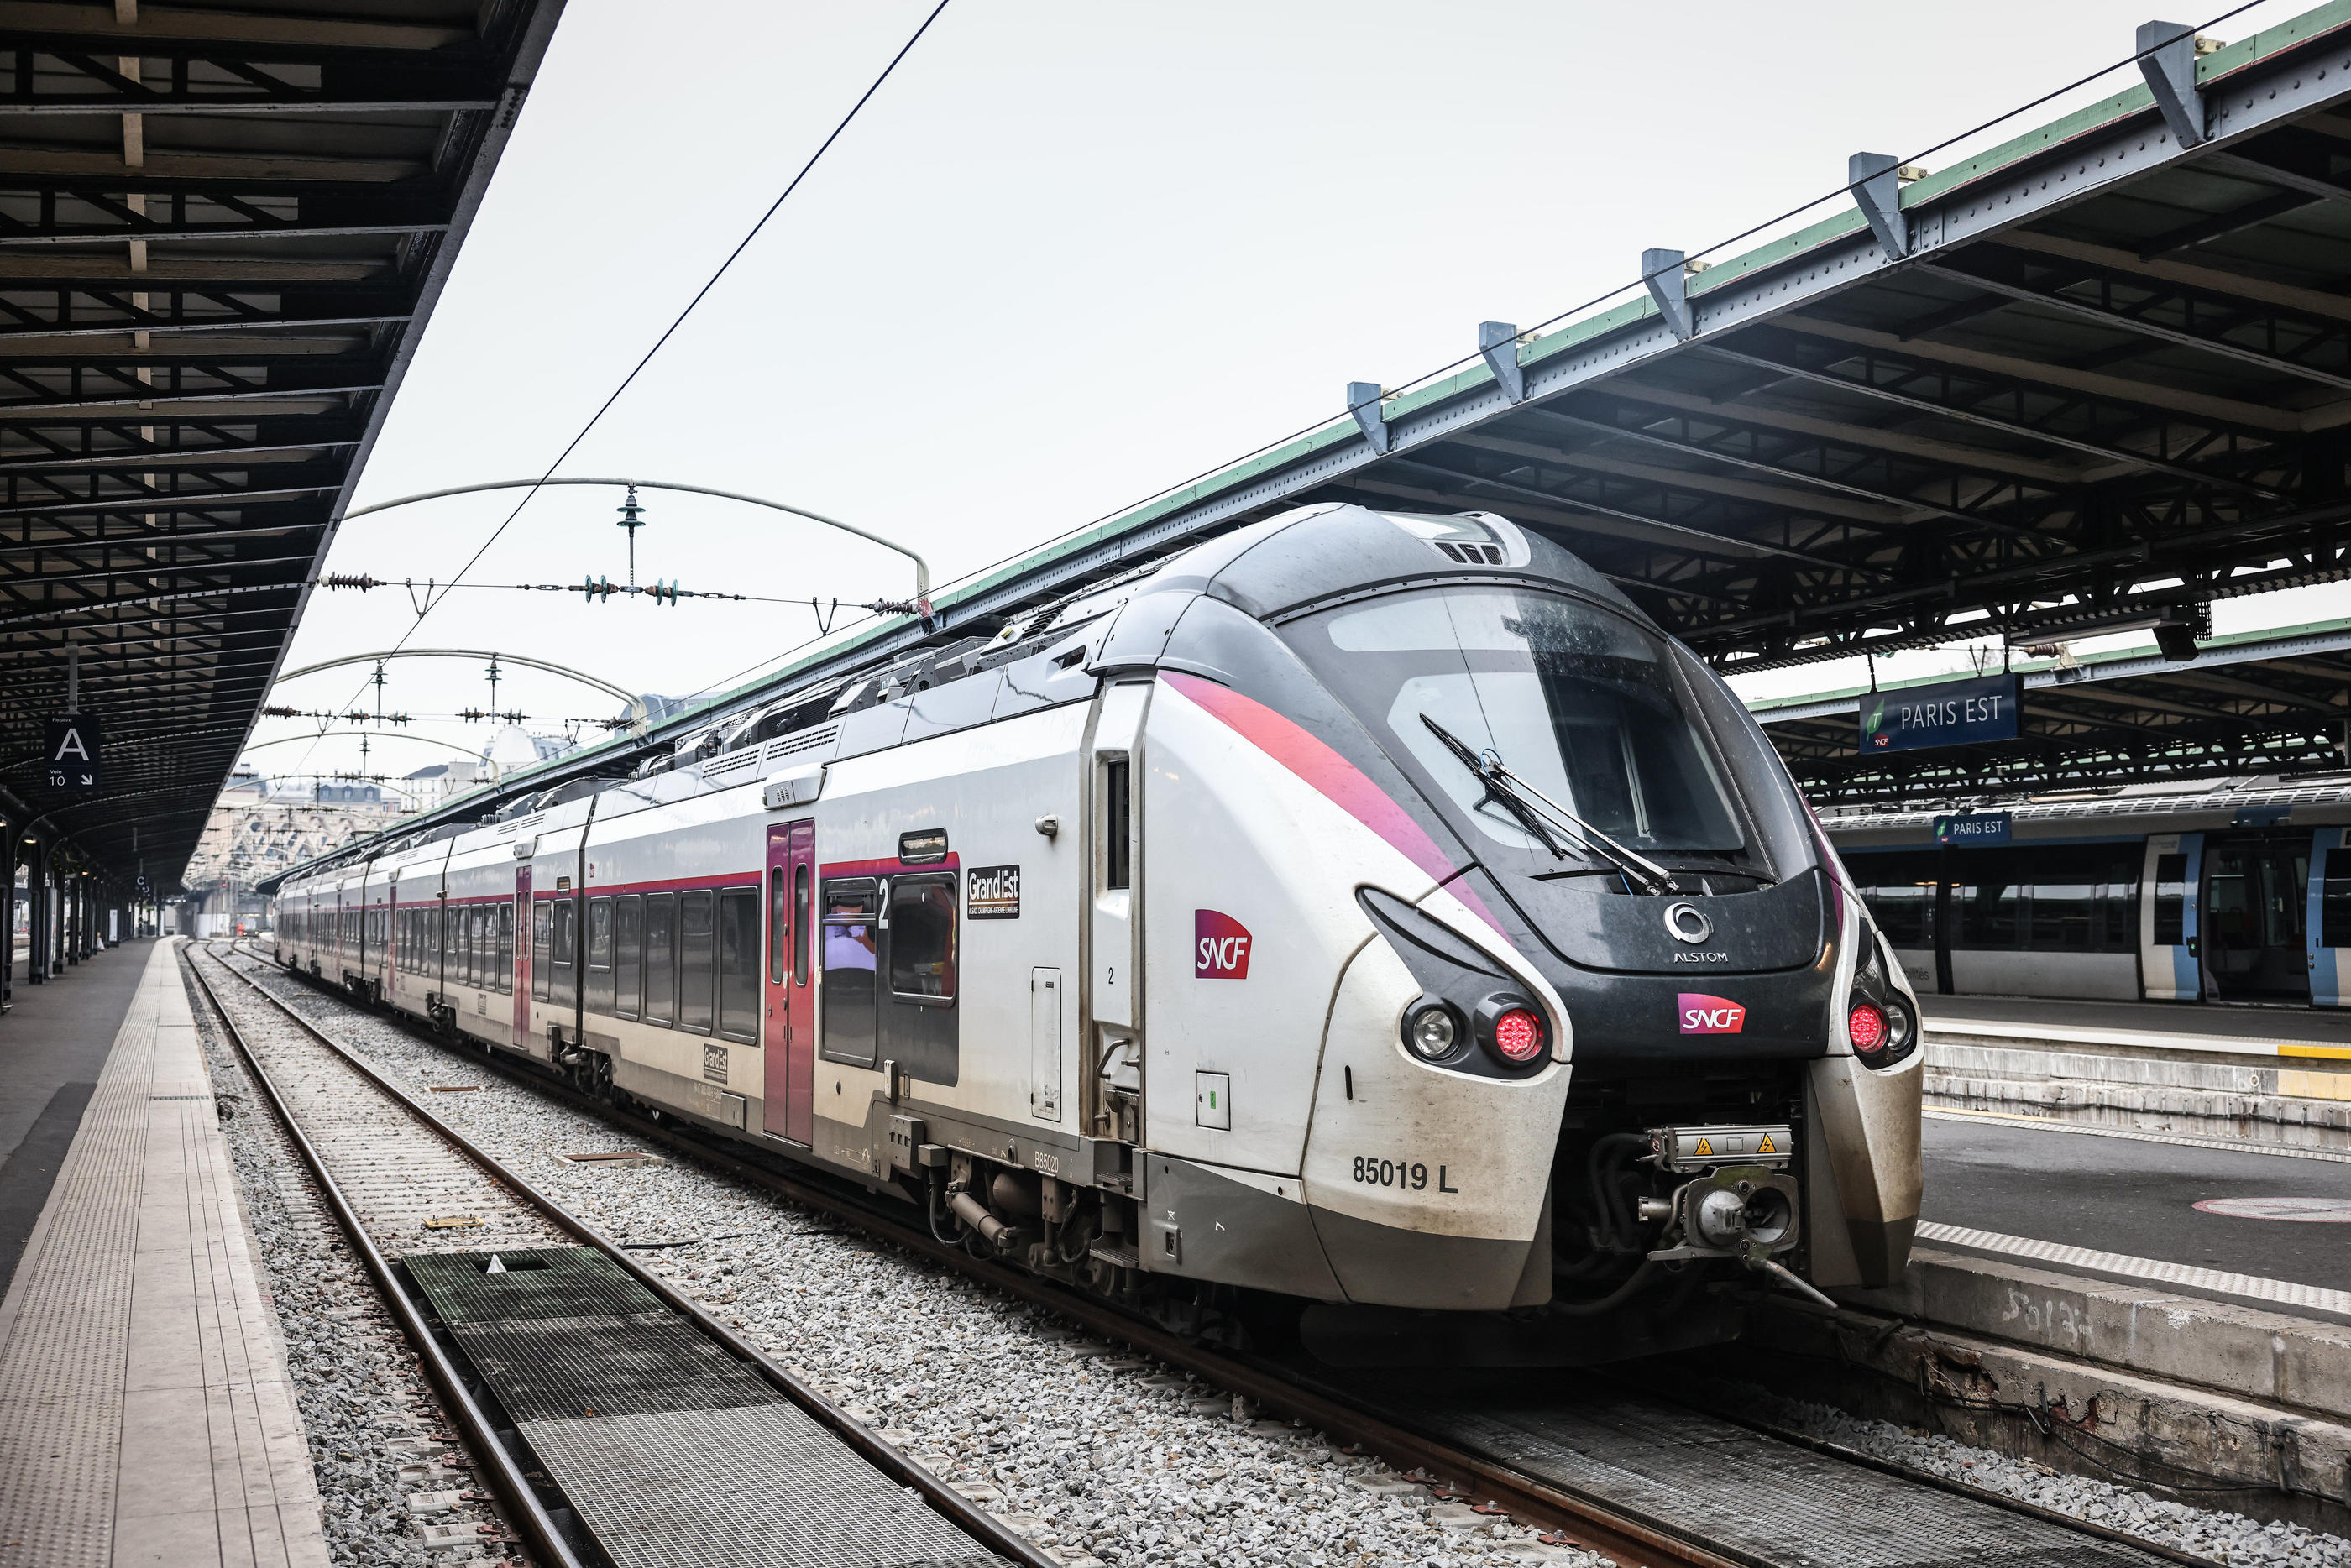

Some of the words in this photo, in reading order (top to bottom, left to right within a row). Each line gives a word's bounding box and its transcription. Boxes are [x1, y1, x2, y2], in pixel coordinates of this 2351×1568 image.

[1902, 701, 1956, 730] PARIS
[1966, 695, 2002, 723] EST
[55, 728, 90, 761] A
[1874, 738, 1888, 746] SNCF
[50, 776, 65, 787] 10
[1954, 823, 1982, 835] PARIS
[1985, 821, 2003, 834] EST
[136, 875, 145, 886] C
[878, 878, 888, 930] 2
[1197, 937, 1249, 970] SNCF
[1673, 952, 1729, 963] ALSTOM
[1108, 966, 1113, 985] 2
[1683, 1009, 1741, 1029] SNCF
[1034, 1150, 1059, 1173] B85020
[1353, 1155, 1427, 1190] 85019
[1439, 1165, 1458, 1194] L
